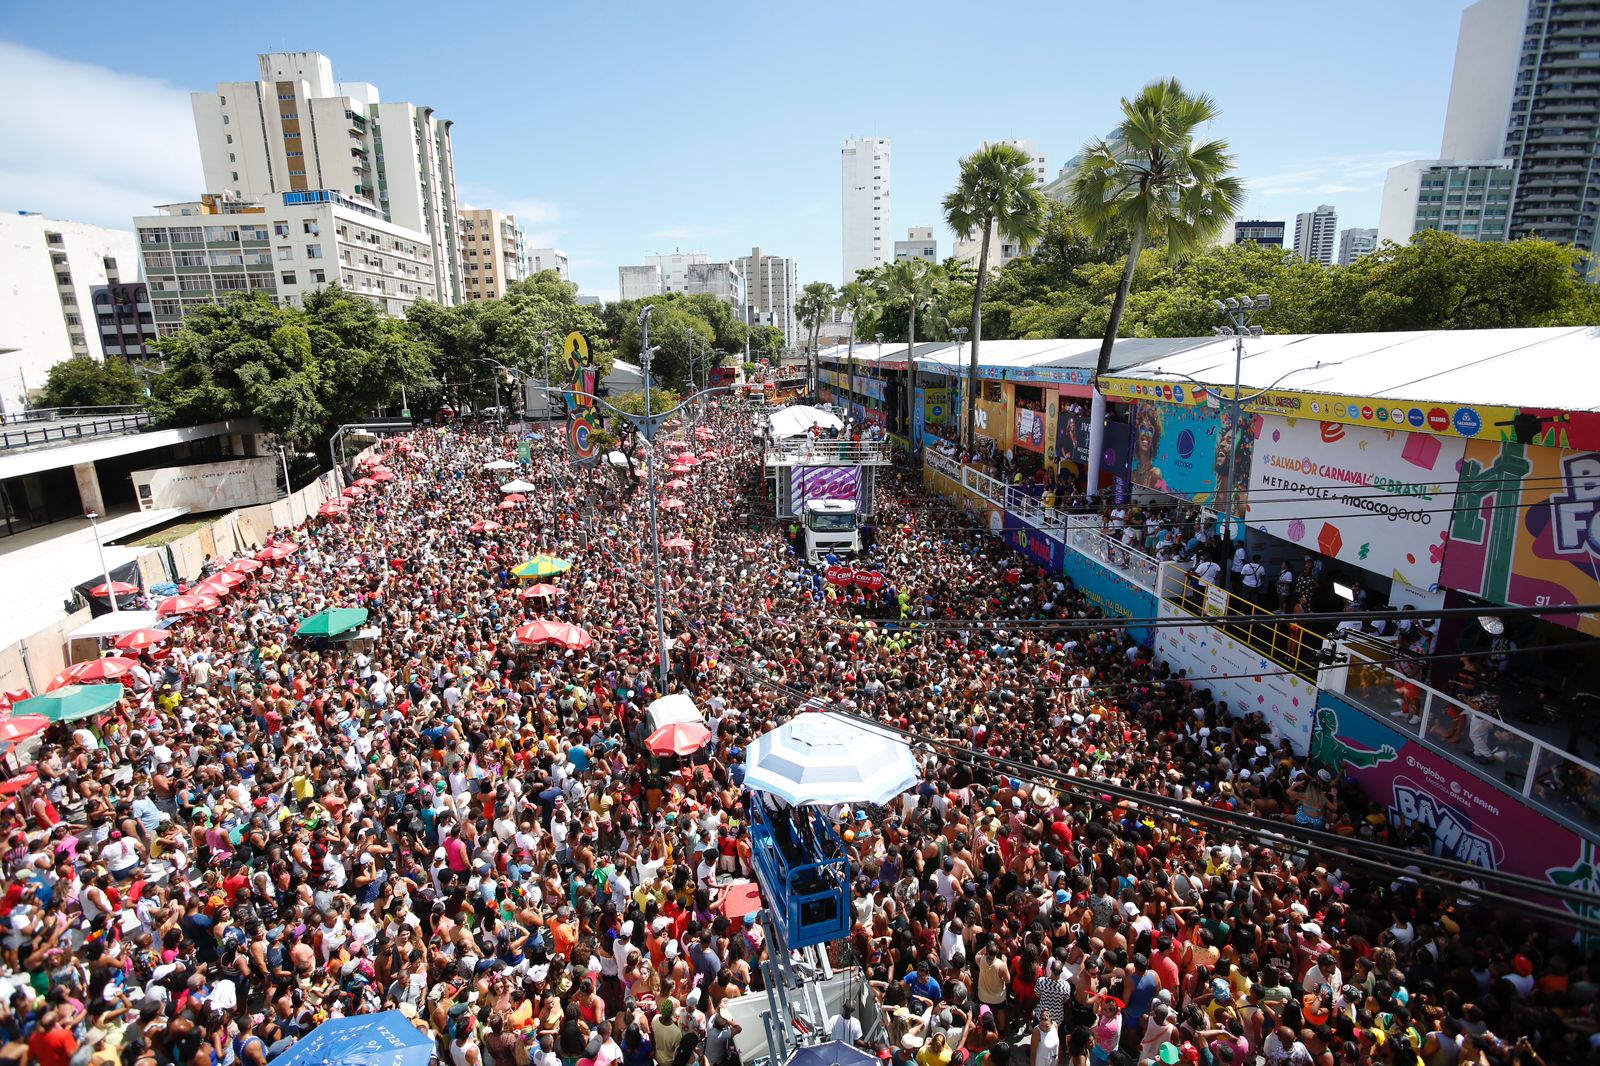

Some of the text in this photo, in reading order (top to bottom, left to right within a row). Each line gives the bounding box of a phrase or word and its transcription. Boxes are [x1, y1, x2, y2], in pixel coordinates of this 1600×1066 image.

[1262, 475, 1329, 499] METROPOLE
[1270, 455, 1318, 475] SALVADOR
[1319, 465, 1371, 486] CARNAVAL
[1387, 479, 1432, 500] BRASIL
[1416, 761, 1445, 783] tvglobo
[1462, 788, 1473, 799] TV
